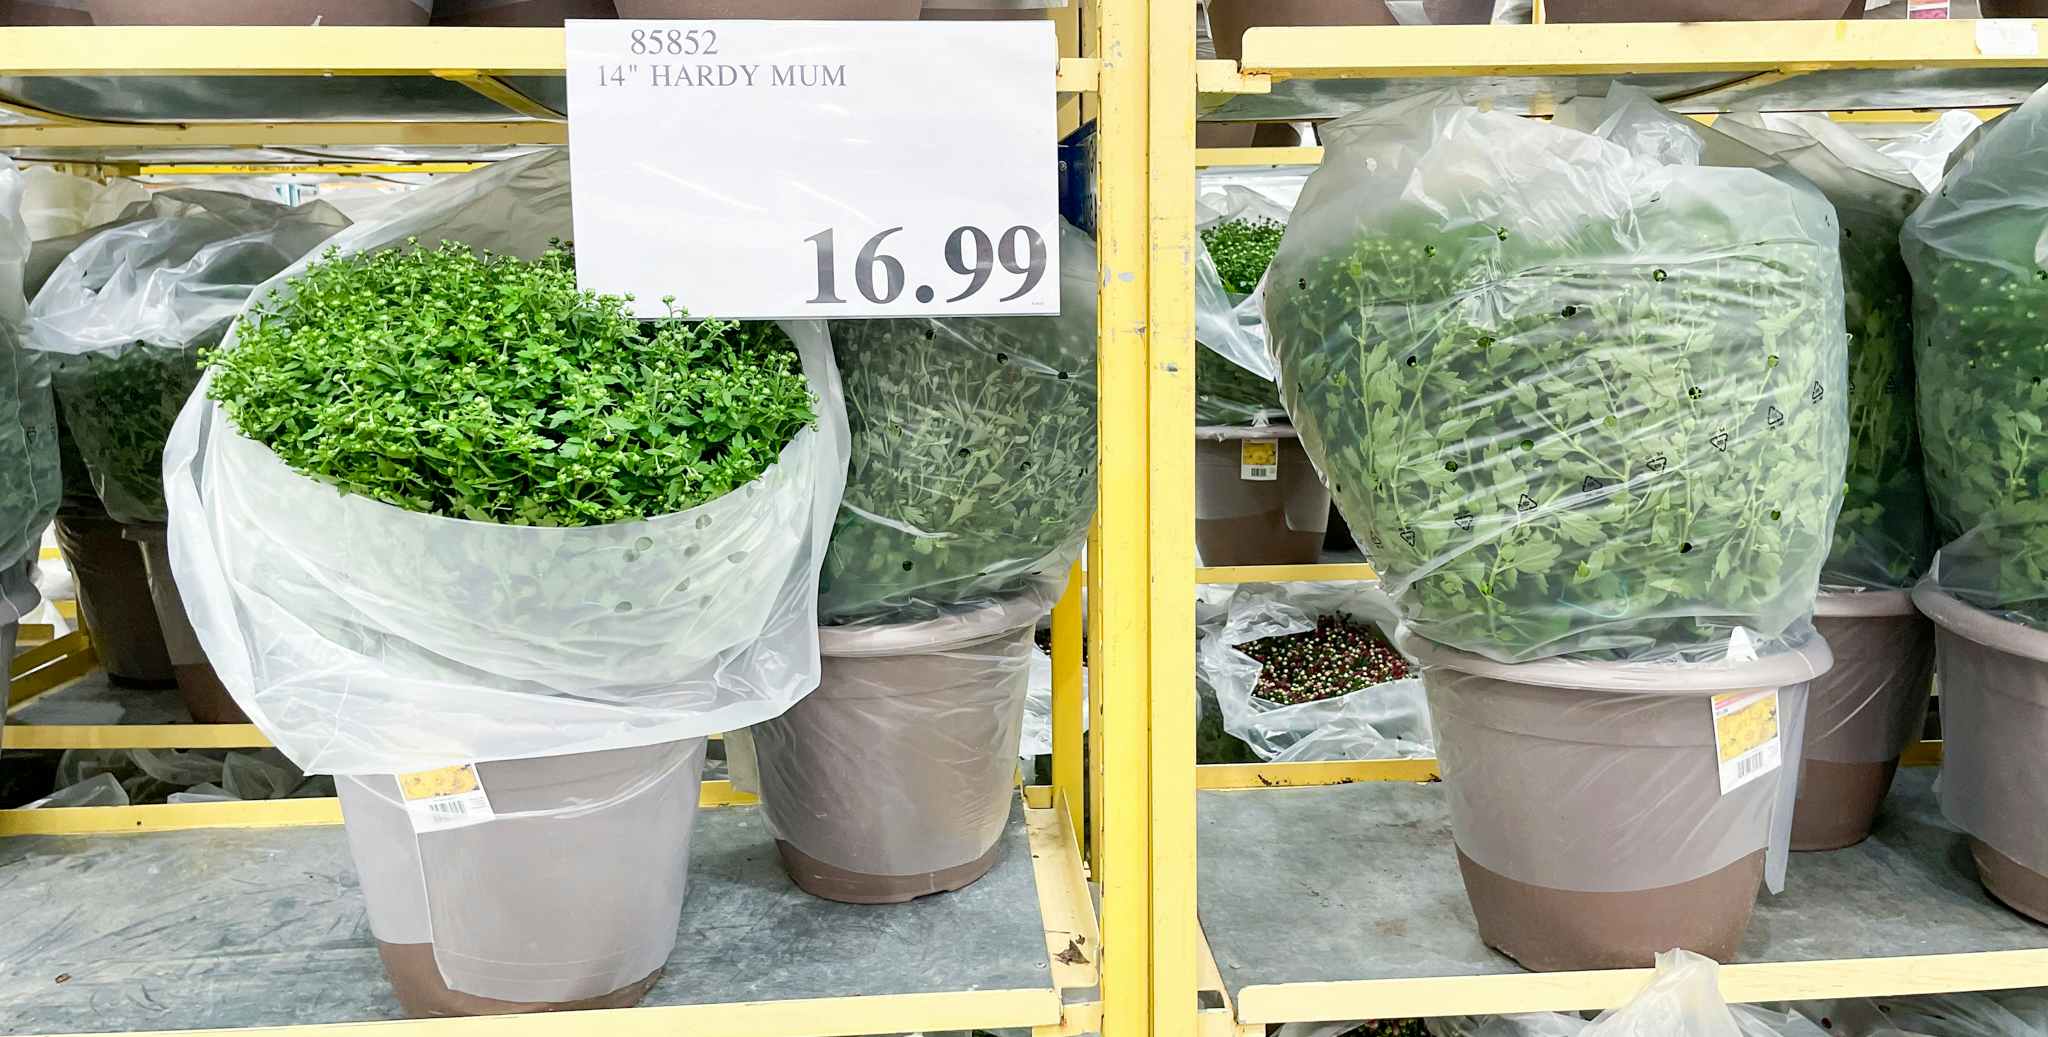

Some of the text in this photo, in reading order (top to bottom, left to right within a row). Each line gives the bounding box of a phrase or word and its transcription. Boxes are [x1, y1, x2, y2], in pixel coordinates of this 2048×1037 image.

[630, 29, 719, 55] 85852
[599, 64, 848, 87] 14" HARDY MUM
[803, 225, 1047, 304] 16.99
